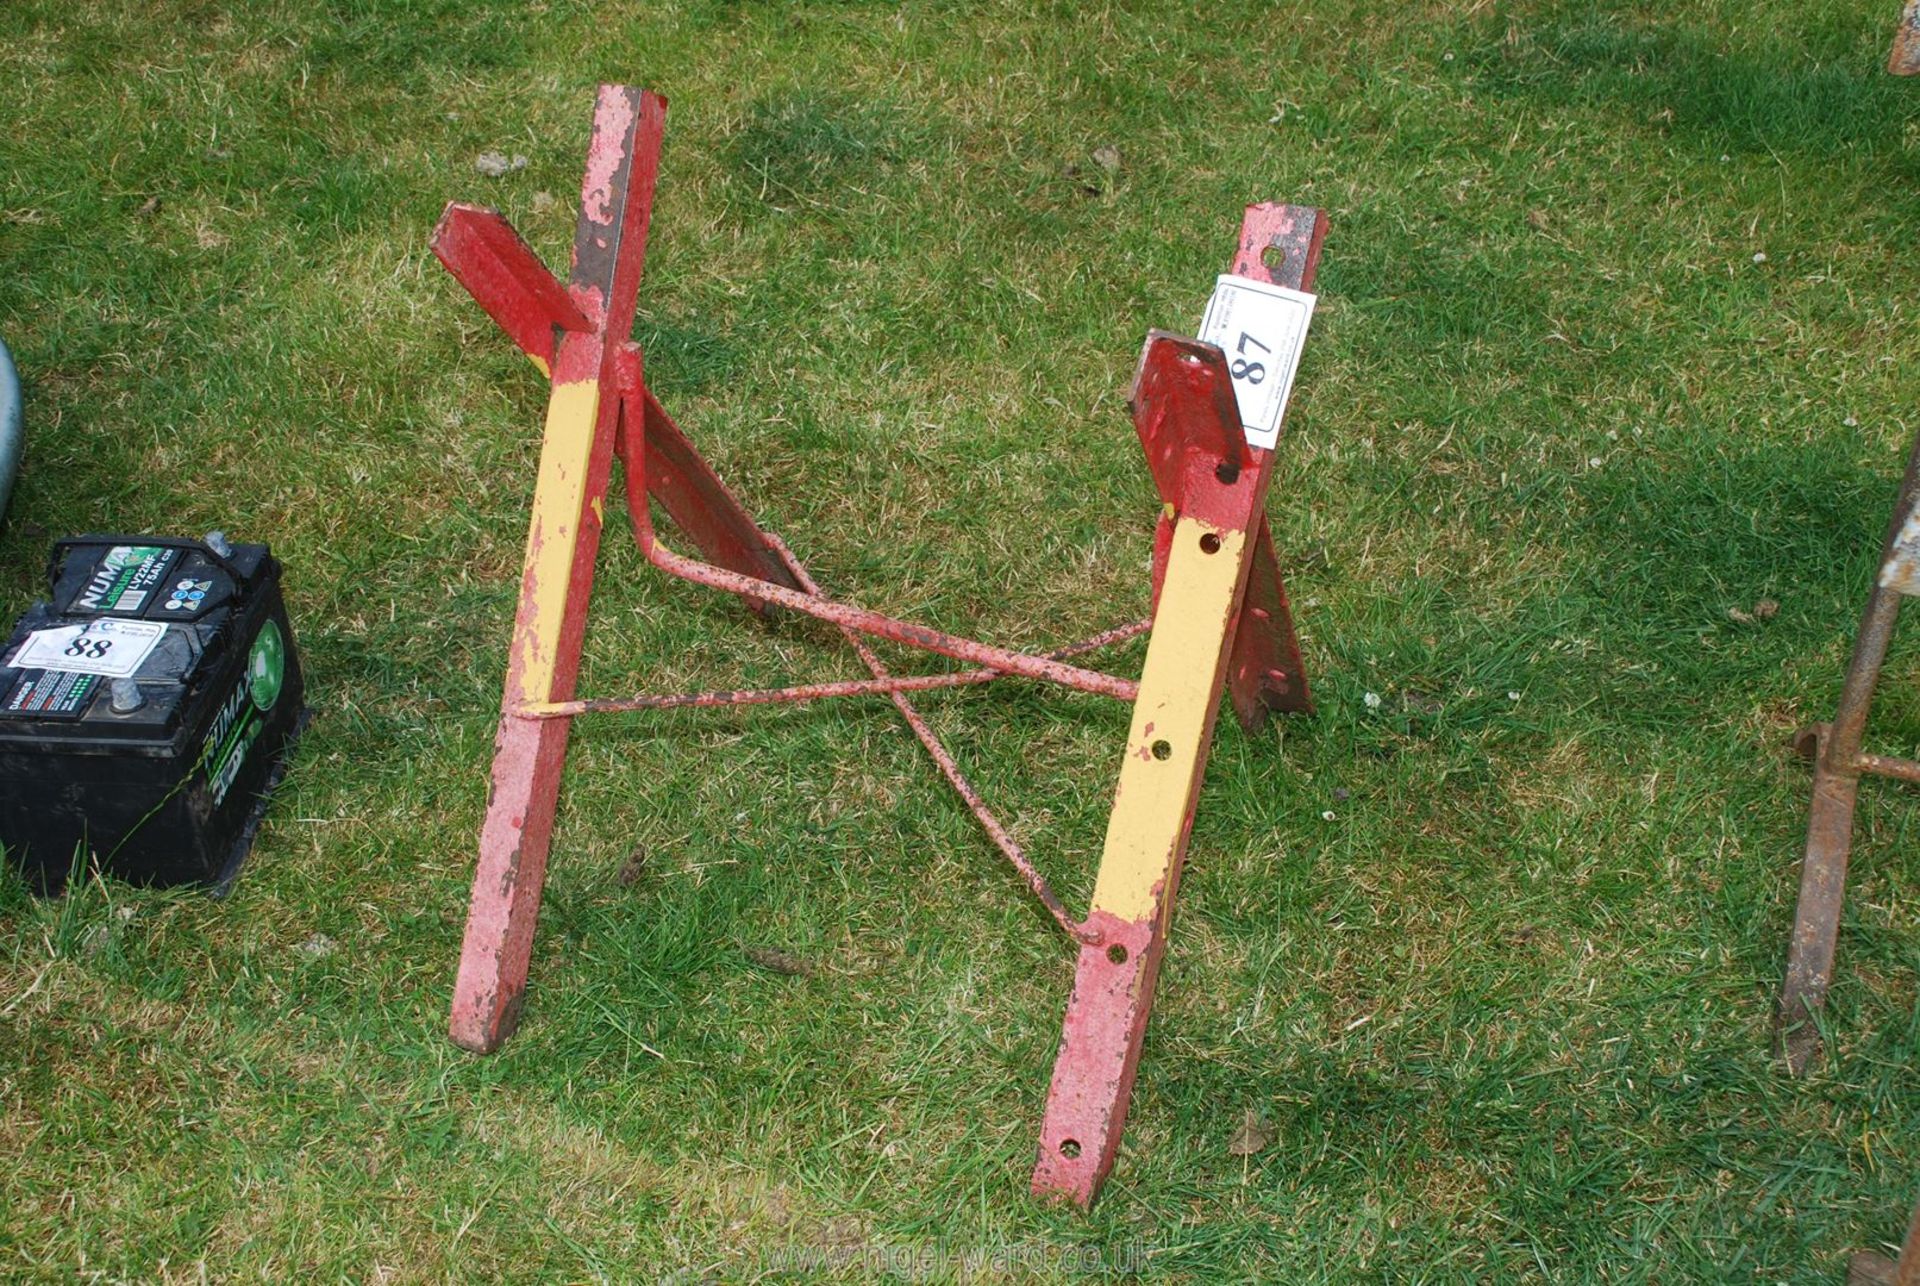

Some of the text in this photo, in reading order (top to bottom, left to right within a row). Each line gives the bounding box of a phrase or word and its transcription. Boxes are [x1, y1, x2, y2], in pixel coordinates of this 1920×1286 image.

[1231, 331, 1271, 385] 87
[99, 568, 136, 610] Leisure
[127, 553, 157, 590] LV22MF
[143, 561, 166, 585] 75Ah
[64, 638, 113, 658] 88
